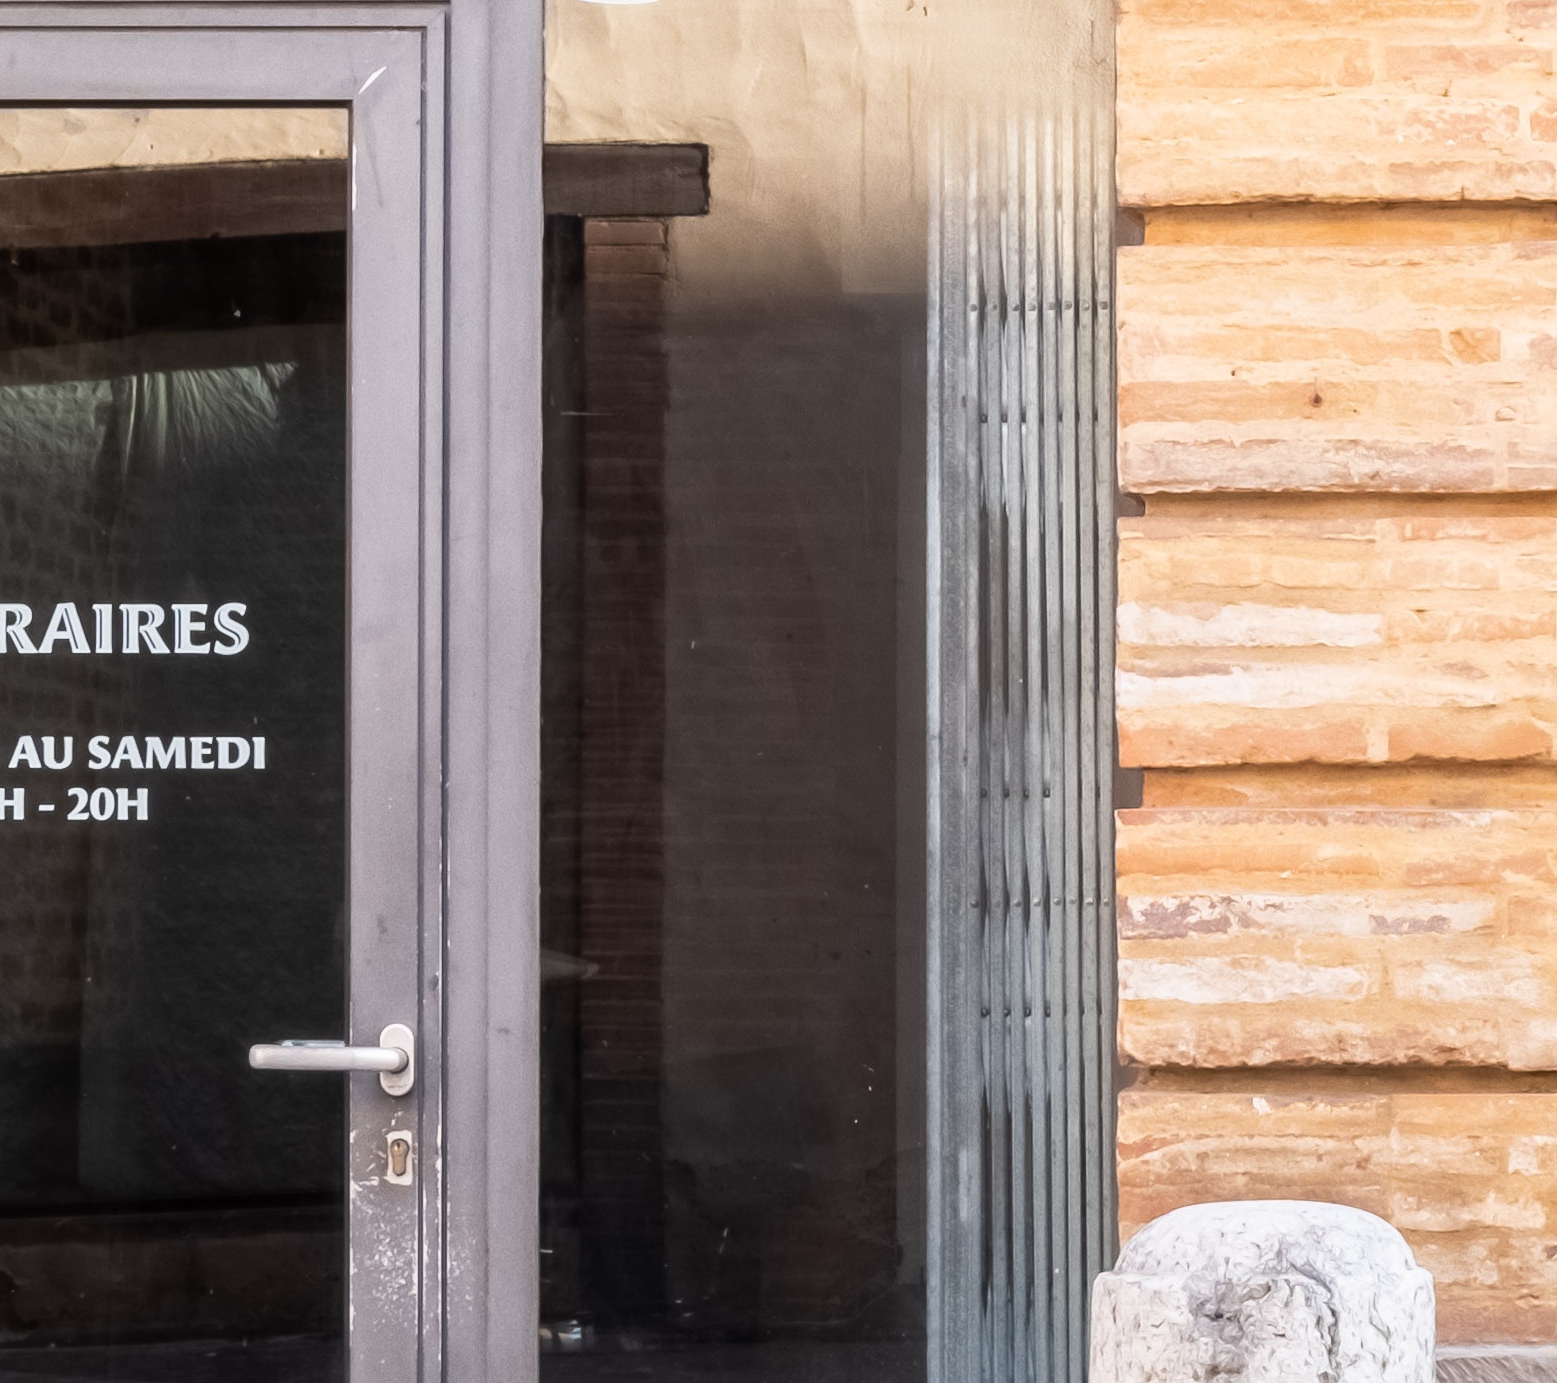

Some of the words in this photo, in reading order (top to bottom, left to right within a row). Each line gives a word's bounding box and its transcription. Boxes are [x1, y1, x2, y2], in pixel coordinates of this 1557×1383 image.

[8, 736, 73, 769] AU
[88, 736, 265, 769] SAMEDI
[67, 788, 148, 820] 20H
